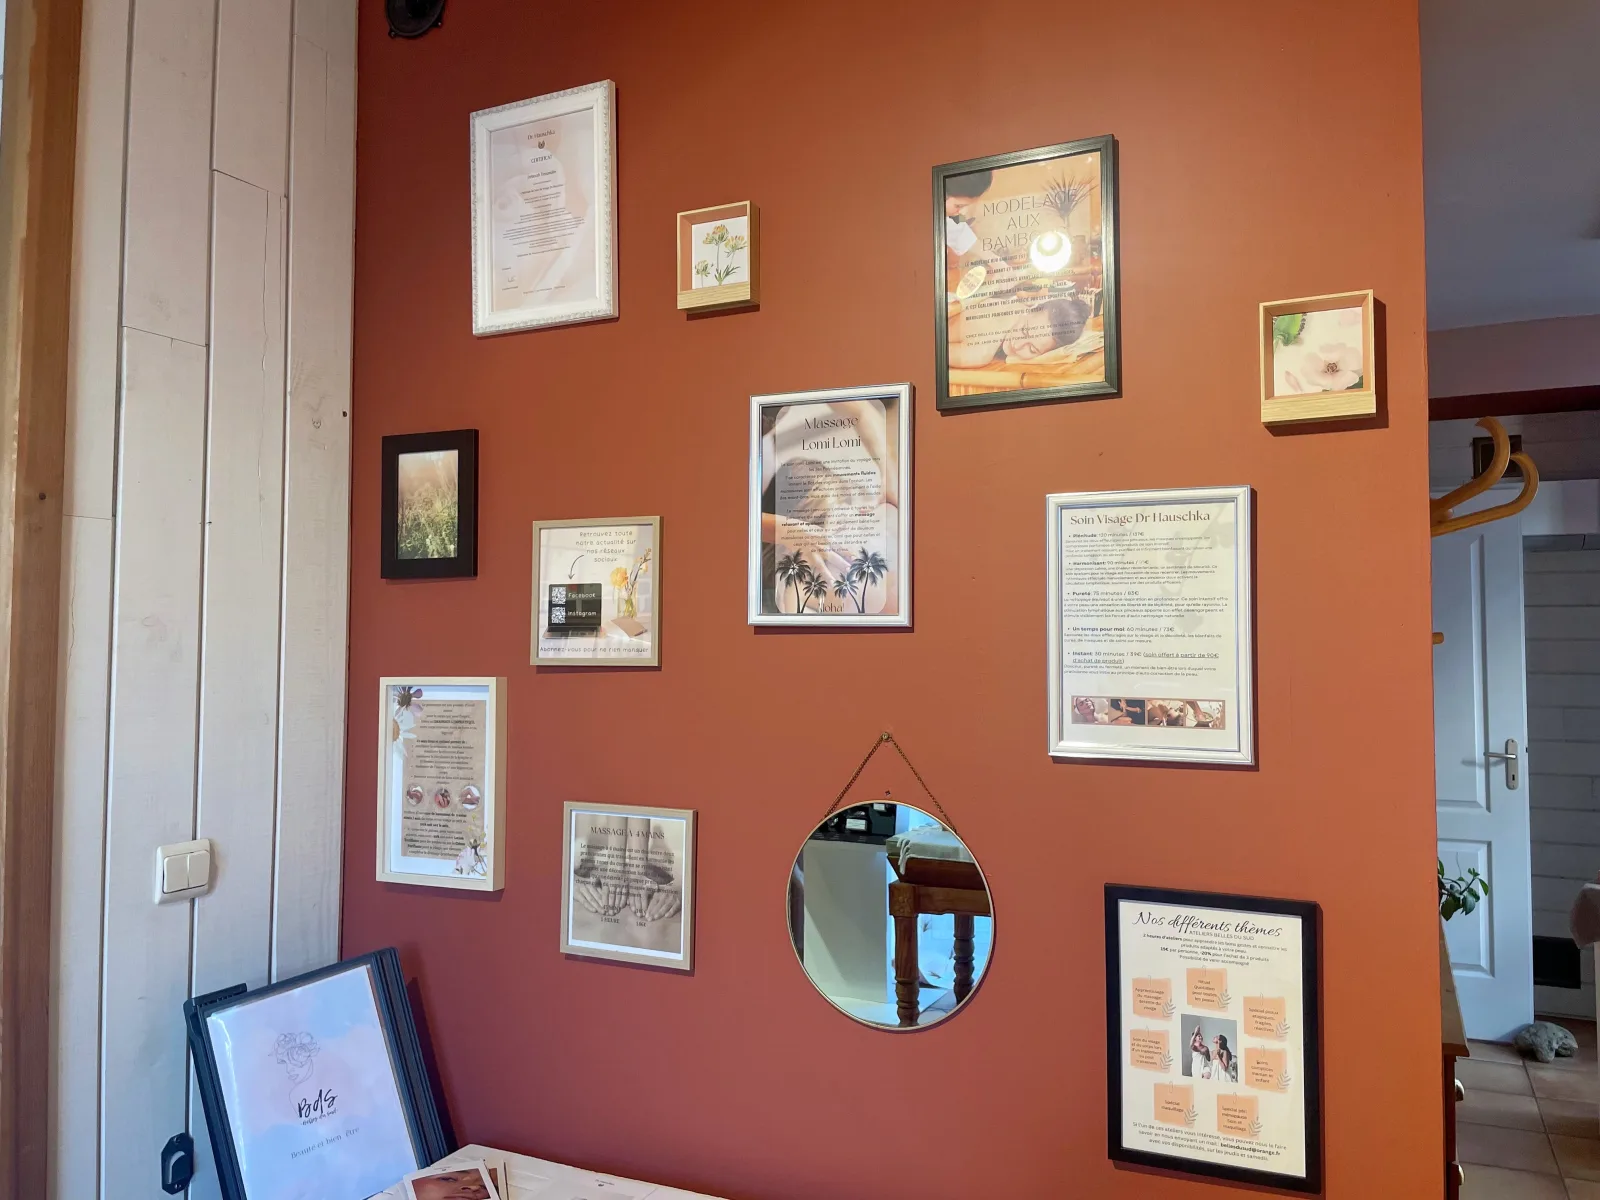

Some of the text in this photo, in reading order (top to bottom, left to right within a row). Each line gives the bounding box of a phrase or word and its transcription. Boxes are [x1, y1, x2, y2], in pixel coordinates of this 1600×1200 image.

[983, 189, 1077, 216] MODELAGE
[1006, 213, 1040, 230] AUX
[805, 416, 858, 430] Massage
[802, 435, 861, 451] Lomi Lomi
[1070, 510, 1210, 526] Soin Visage Dr Hauschka
[591, 826, 626, 836] MASSAGE
[1132, 912, 1283, 937] Nos différents thèmes
[298, 1089, 338, 1118] BdS
[325, 1135, 342, 1145] bien
